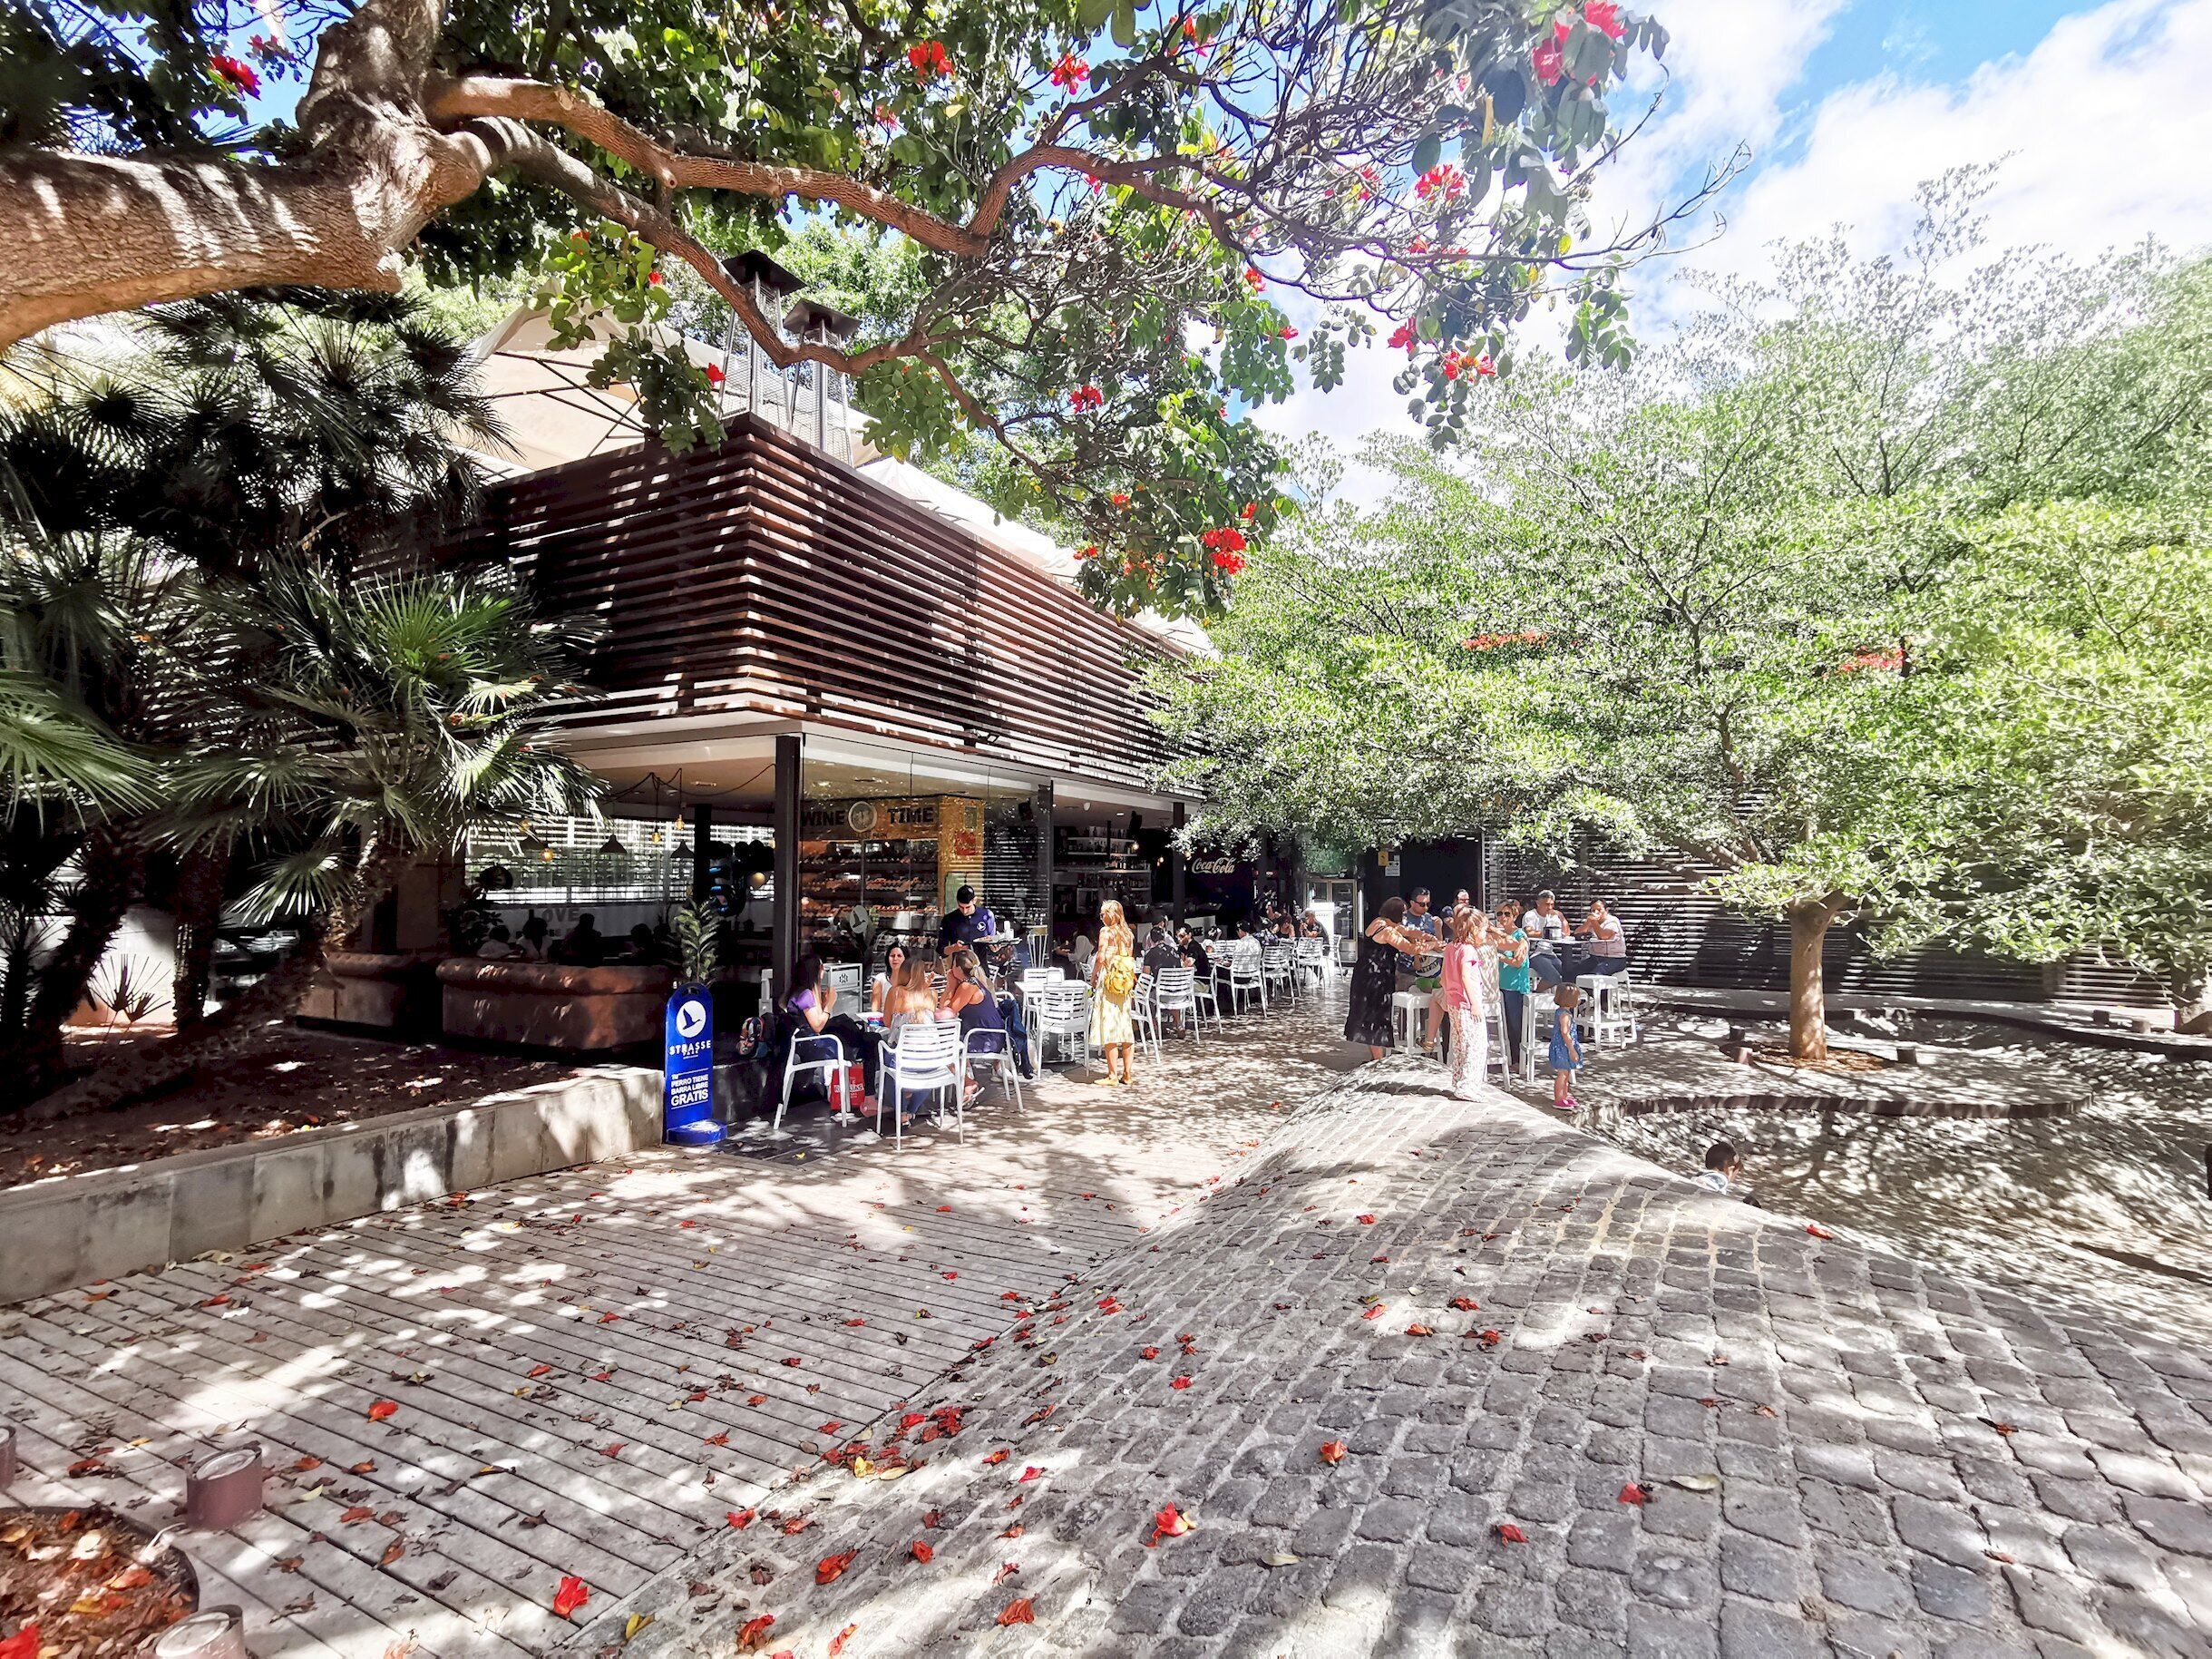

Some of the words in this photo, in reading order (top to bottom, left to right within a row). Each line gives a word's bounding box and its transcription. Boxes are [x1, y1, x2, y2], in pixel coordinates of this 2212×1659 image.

[801, 810, 845, 827] WINE
[887, 807, 934, 825] TIME
[1192, 856, 1237, 873] Coca-Cola
[668, 1039, 711, 1055] STRASSE
[671, 1078, 692, 1088] PERRO
[692, 1074, 708, 1083] TIENE
[671, 1085, 692, 1095] BARRA
[692, 1081, 708, 1089] LIBRE
[671, 1088, 709, 1106] GRATIS
